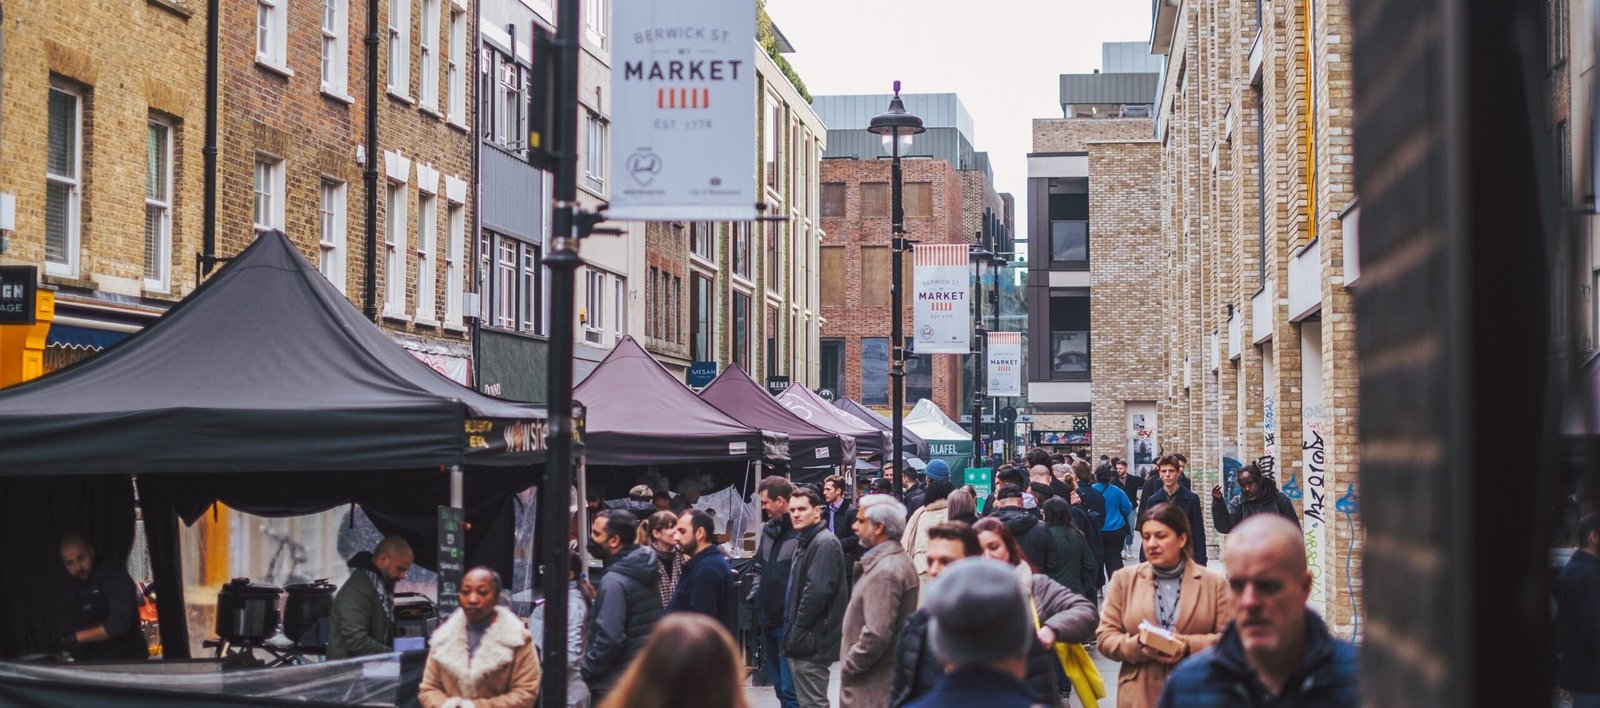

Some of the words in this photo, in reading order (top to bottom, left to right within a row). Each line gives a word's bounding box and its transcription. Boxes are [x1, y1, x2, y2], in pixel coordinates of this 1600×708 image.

[634, 26, 704, 44] BERWICK
[624, 60, 742, 81] MARKET
[918, 291, 965, 301] MARKET
[691, 368, 717, 376] MISAN
